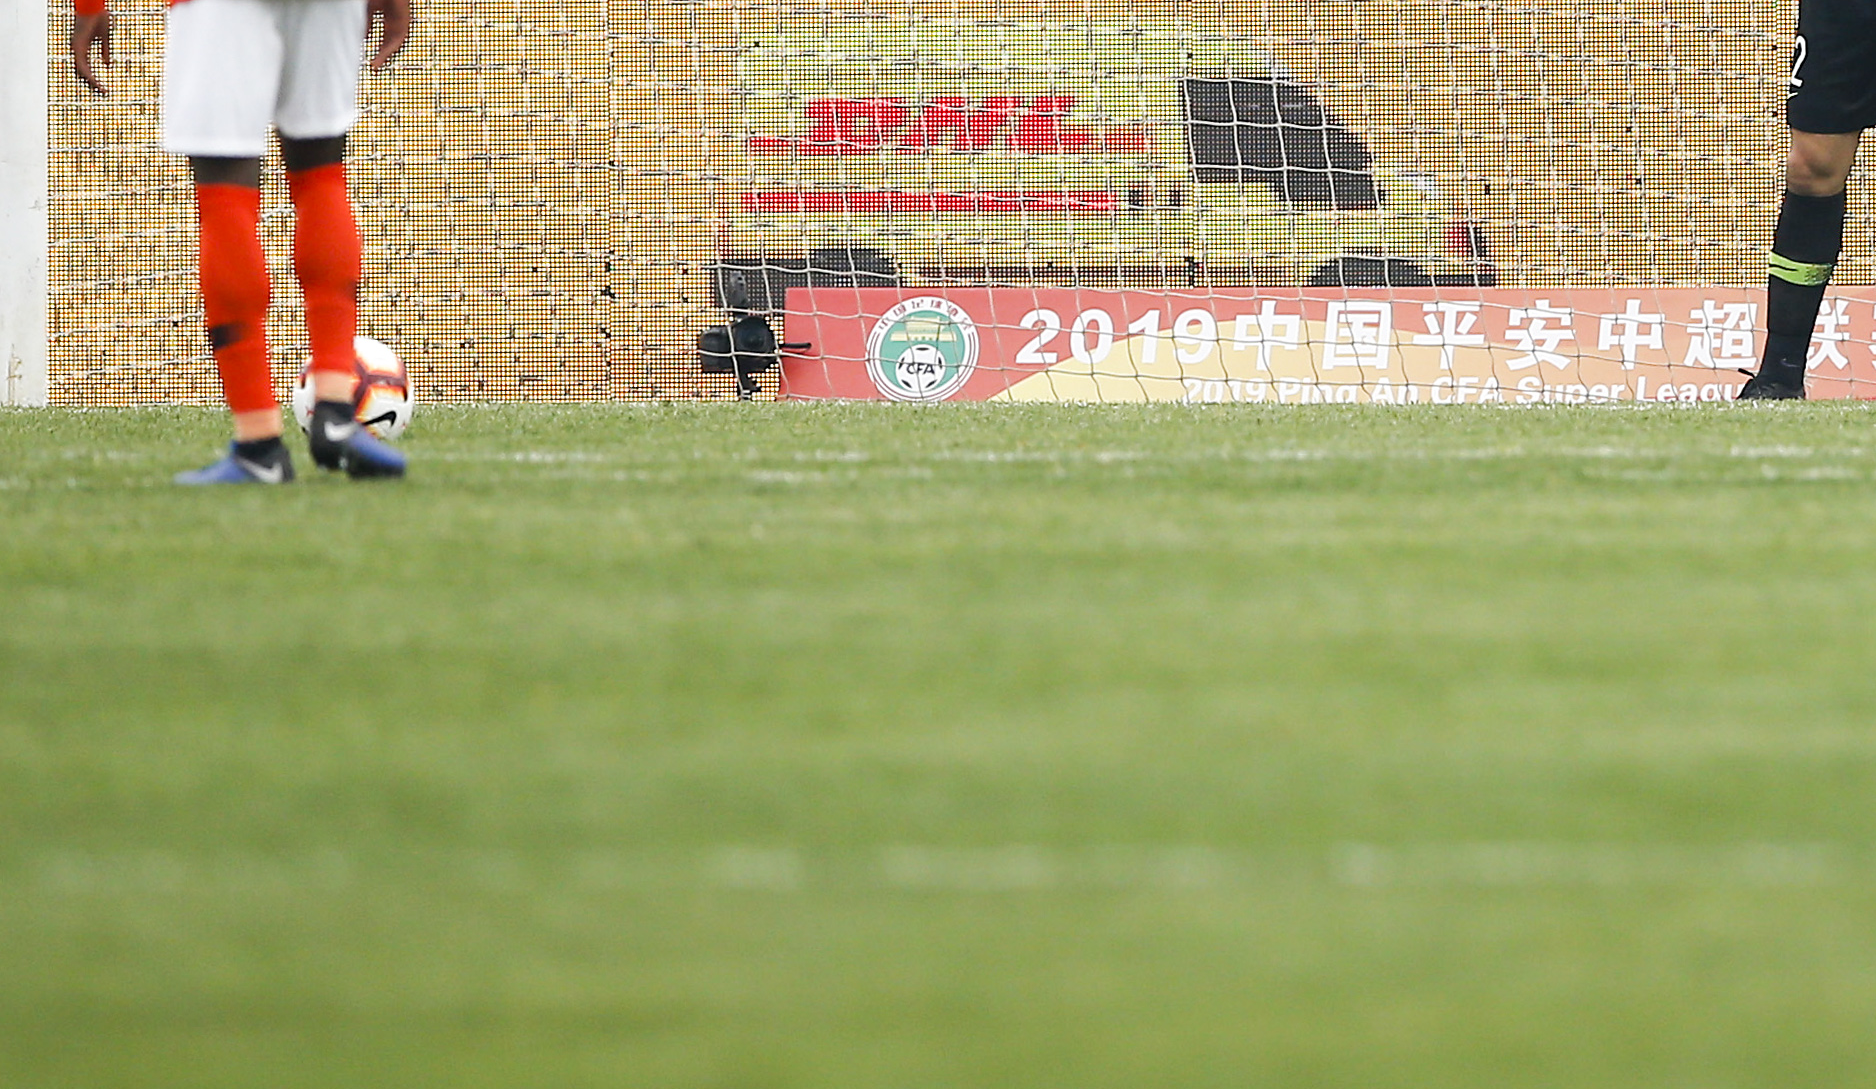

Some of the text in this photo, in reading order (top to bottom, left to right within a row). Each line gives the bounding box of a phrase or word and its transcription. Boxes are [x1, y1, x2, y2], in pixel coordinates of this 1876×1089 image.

[906, 361, 936, 375] CFA
[1183, 378, 1267, 405] 2019
[1371, 377, 1418, 405] An
[1431, 376, 1506, 404] CFA
[1516, 376, 1625, 404] Super
[1634, 375, 1744, 403] Leagu
